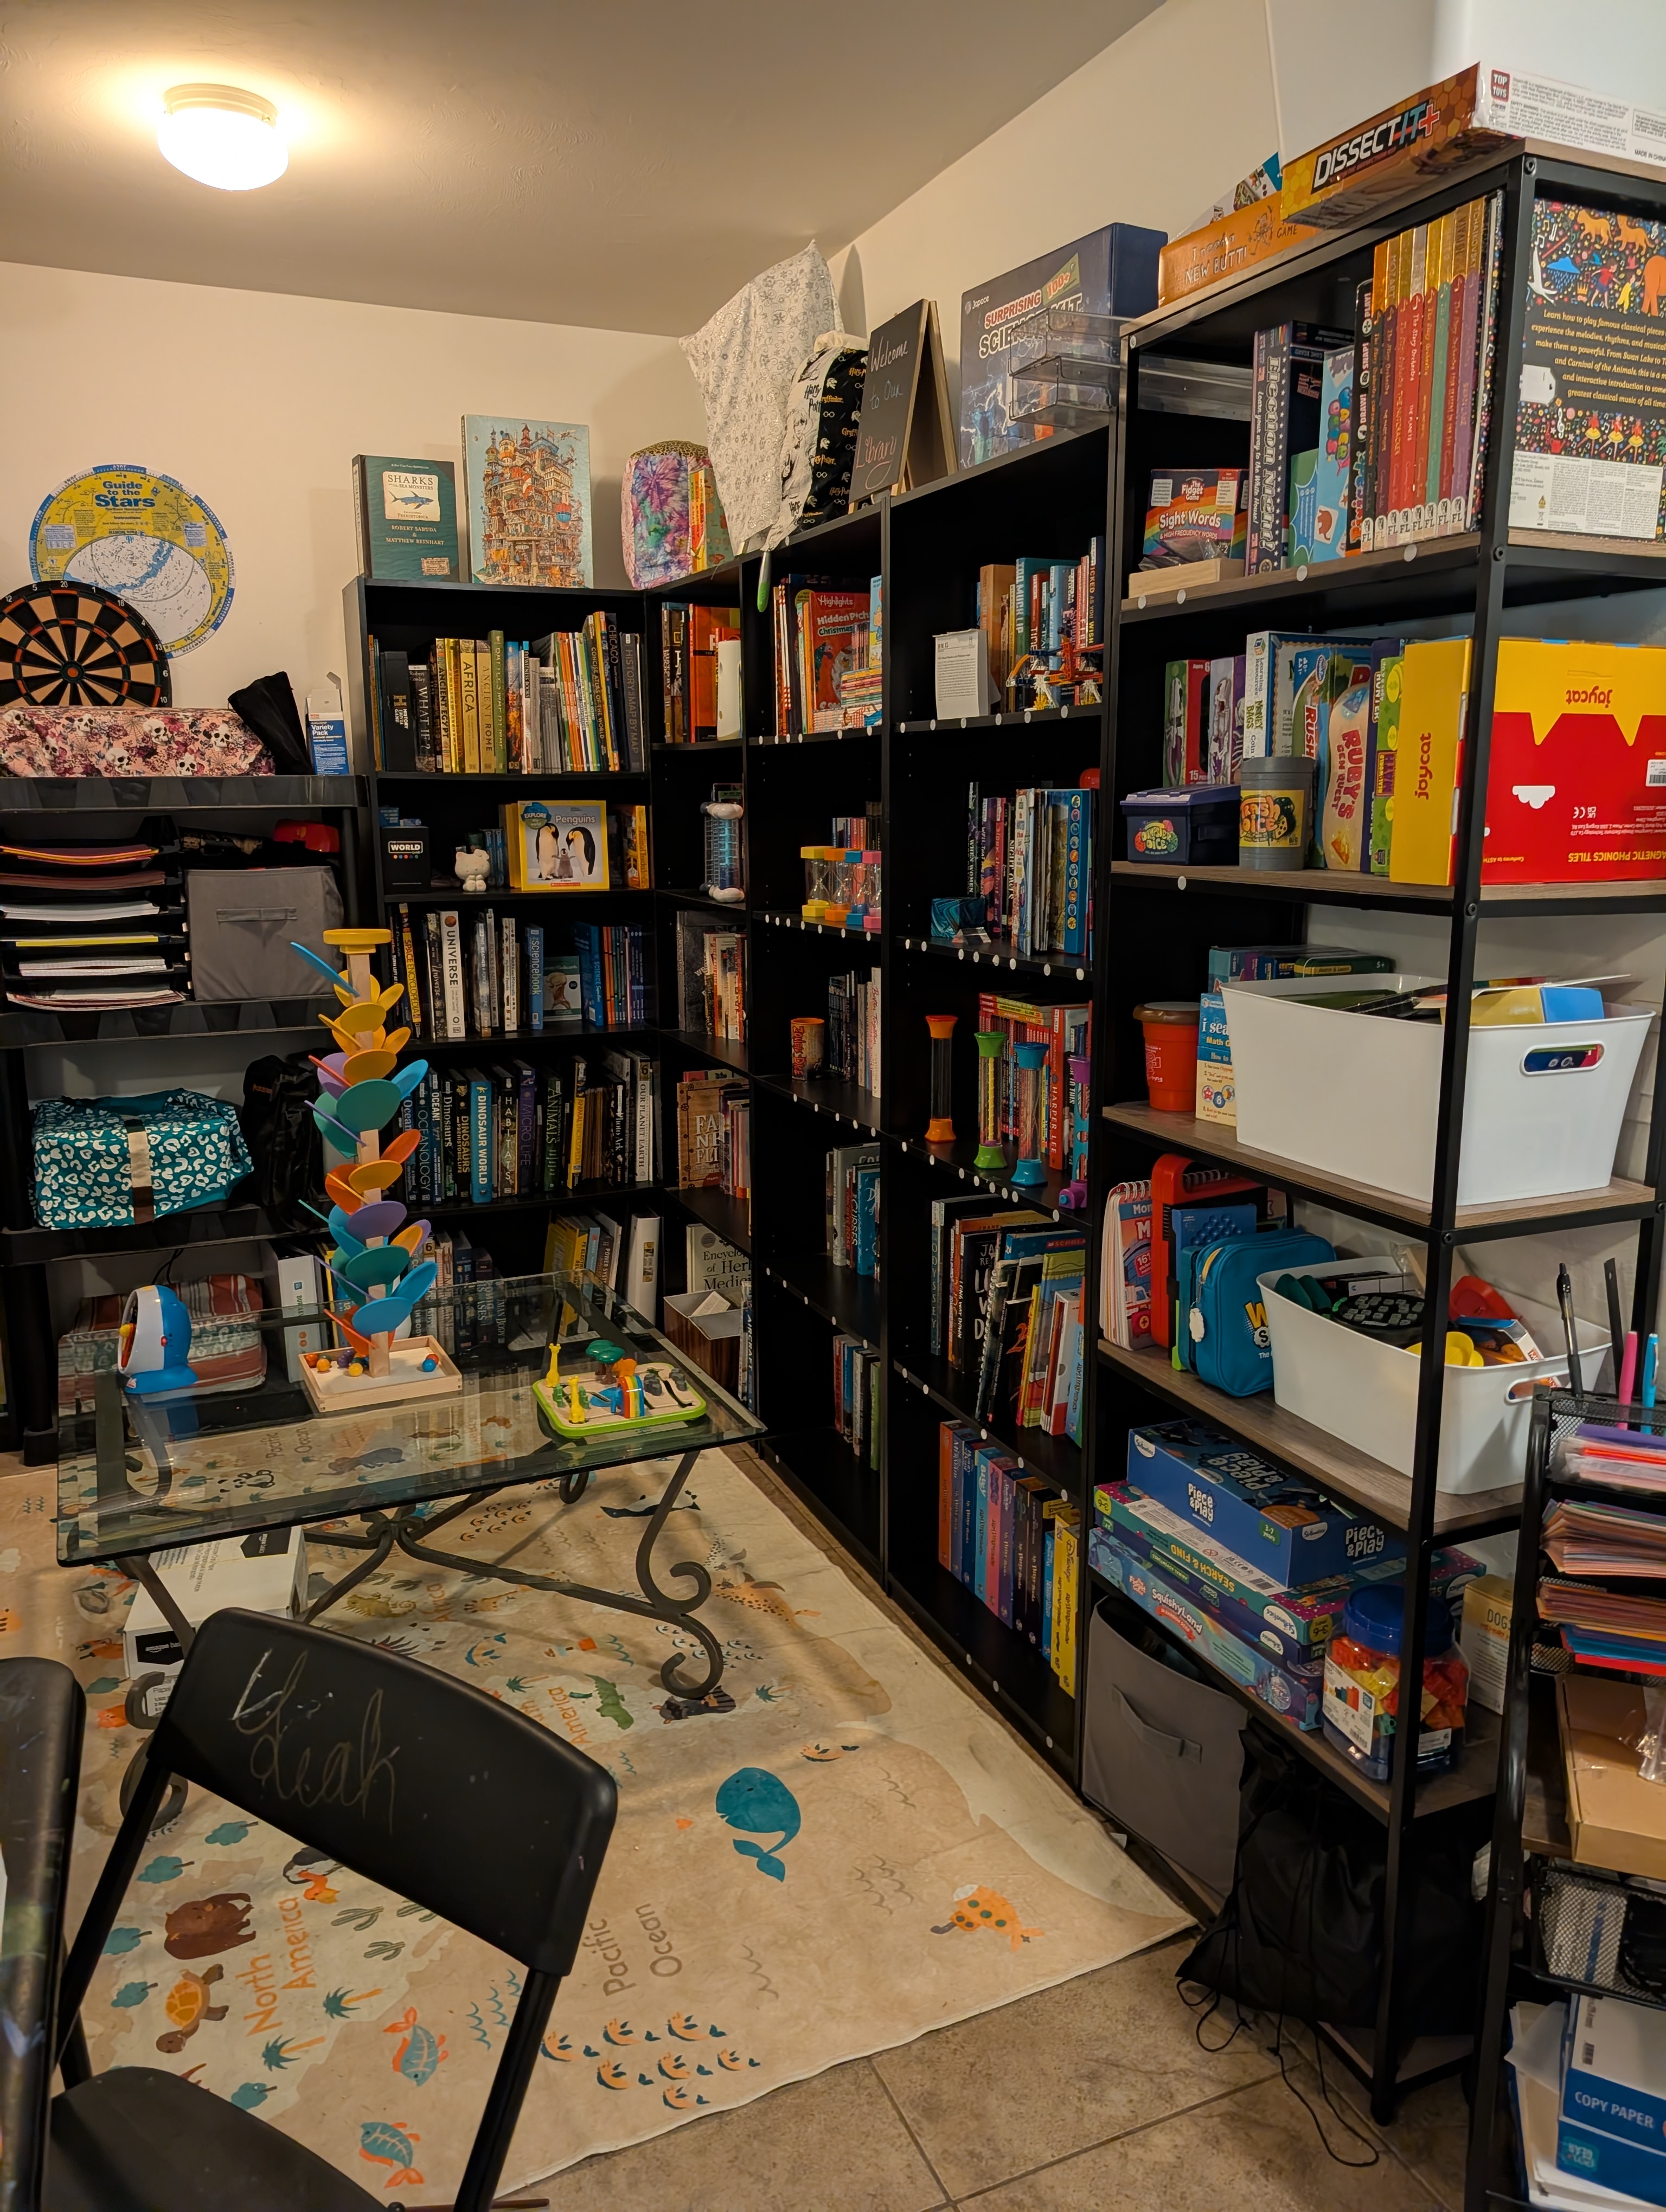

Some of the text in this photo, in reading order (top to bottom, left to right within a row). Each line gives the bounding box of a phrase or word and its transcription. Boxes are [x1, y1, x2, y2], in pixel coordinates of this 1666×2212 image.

[1492, 87, 1507, 98] TOYS
[1494, 74, 1507, 85] TOP
[1277, 224, 1297, 239] GAME
[985, 290, 1041, 329] SURPRISING
[1544, 310, 1664, 336] Learn how to play famous classical pieces
[870, 336, 908, 373] Welcome
[1554, 341, 1568, 351] them
[1607, 350, 1622, 359] From
[1623, 352, 1638, 361] Swan
[1641, 354, 1654, 363] Lake
[1655, 357, 1661, 365] to
[1555, 357, 1566, 366] and
[1568, 358, 1593, 369] Carnival
[1594, 361, 1601, 372] of
[1601, 363, 1611, 372] the
[1612, 365, 1637, 376] Animals,
[1638, 368, 1649, 378] this
[1562, 373, 1574, 381] and
[1576, 375, 1607, 385] interactive
[1609, 378, 1643, 390] introduction
[1645, 384, 1651, 392] to
[1255, 391, 1264, 413] Learn
[1253, 414, 1263, 433] your
[1253, 434, 1261, 451] way
[1259, 357, 1280, 551] Election Night!
[1254, 452, 1262, 460] to
[102, 481, 143, 489] Guide
[388, 474, 433, 485] SHARKS
[1181, 485, 1203, 496] Fidget
[1253, 474, 1261, 496] White
[95, 494, 156, 508] Stars
[1159, 510, 1221, 529] Sight Words
[1388, 525, 1398, 535] FL
[1400, 523, 1410, 533] FL
[1412, 520, 1422, 531] FL
[1438, 515, 1449, 524] FL
[1452, 512, 1463, 522] FL
[1202, 530, 1218, 539] WORDS
[1016, 560, 1024, 583] TOO
[818, 596, 854, 607] Highlights
[1017, 616, 1025, 634] LIP
[608, 625, 619, 664] CHICAGO
[463, 661, 475, 713] AFRICA
[591, 647, 599, 674] CONCISE
[595, 695, 601, 703] OF
[418, 686, 430, 726] WHAT
[483, 666, 493, 751] ANCIENT ROME
[625, 650, 639, 753] HISTORY MAP BY MAP
[1566, 685, 1613, 709] joycat
[1246, 705, 1254, 730] BAGS
[420, 729, 431, 740] IF
[1302, 705, 1317, 760] RUSH
[1189, 770, 1198, 780] 15
[1331, 744, 1345, 809] GEM QUEST
[1337, 729, 1363, 819] RUBY'S
[1384, 754, 1393, 792] MATH
[1414, 732, 1433, 800] joycat
[555, 815, 595, 826] Penguins
[447, 930, 458, 986] UNIVERSE
[404, 940, 420, 1014] SPACE ENCYCLOPEDIA
[1206, 1036, 1223, 1046] Math
[1210, 1052, 1221, 1060] How
[431, 1092, 440, 1121] OCEAN!
[546, 1087, 562, 1144] ANIMALS
[444, 1096, 453, 1147] Dinosaurs
[574, 1099, 584, 1165] ANIMAL ENCYCLOPEDIA
[462, 1116, 470, 1173] DINOSAURS
[478, 1095, 488, 1184] DINOSAUR WORLD
[504, 1096, 513, 1180] HABITATS
[520, 1104, 533, 1166] MICRO LIFE
[262, 1433, 285, 1459] Pacific
[1188, 1483, 1214, 1509] Piece
[1171, 1544, 1235, 1593] SEARCH & FIND
[548, 1686, 594, 1746] America
[278, 1897, 316, 1991] America
[635, 1903, 682, 1977] Ocean
[581, 1918, 637, 1996] Pacific
[236, 1953, 283, 2037] North
[1574, 2091, 1655, 2129] COPY PAPER
